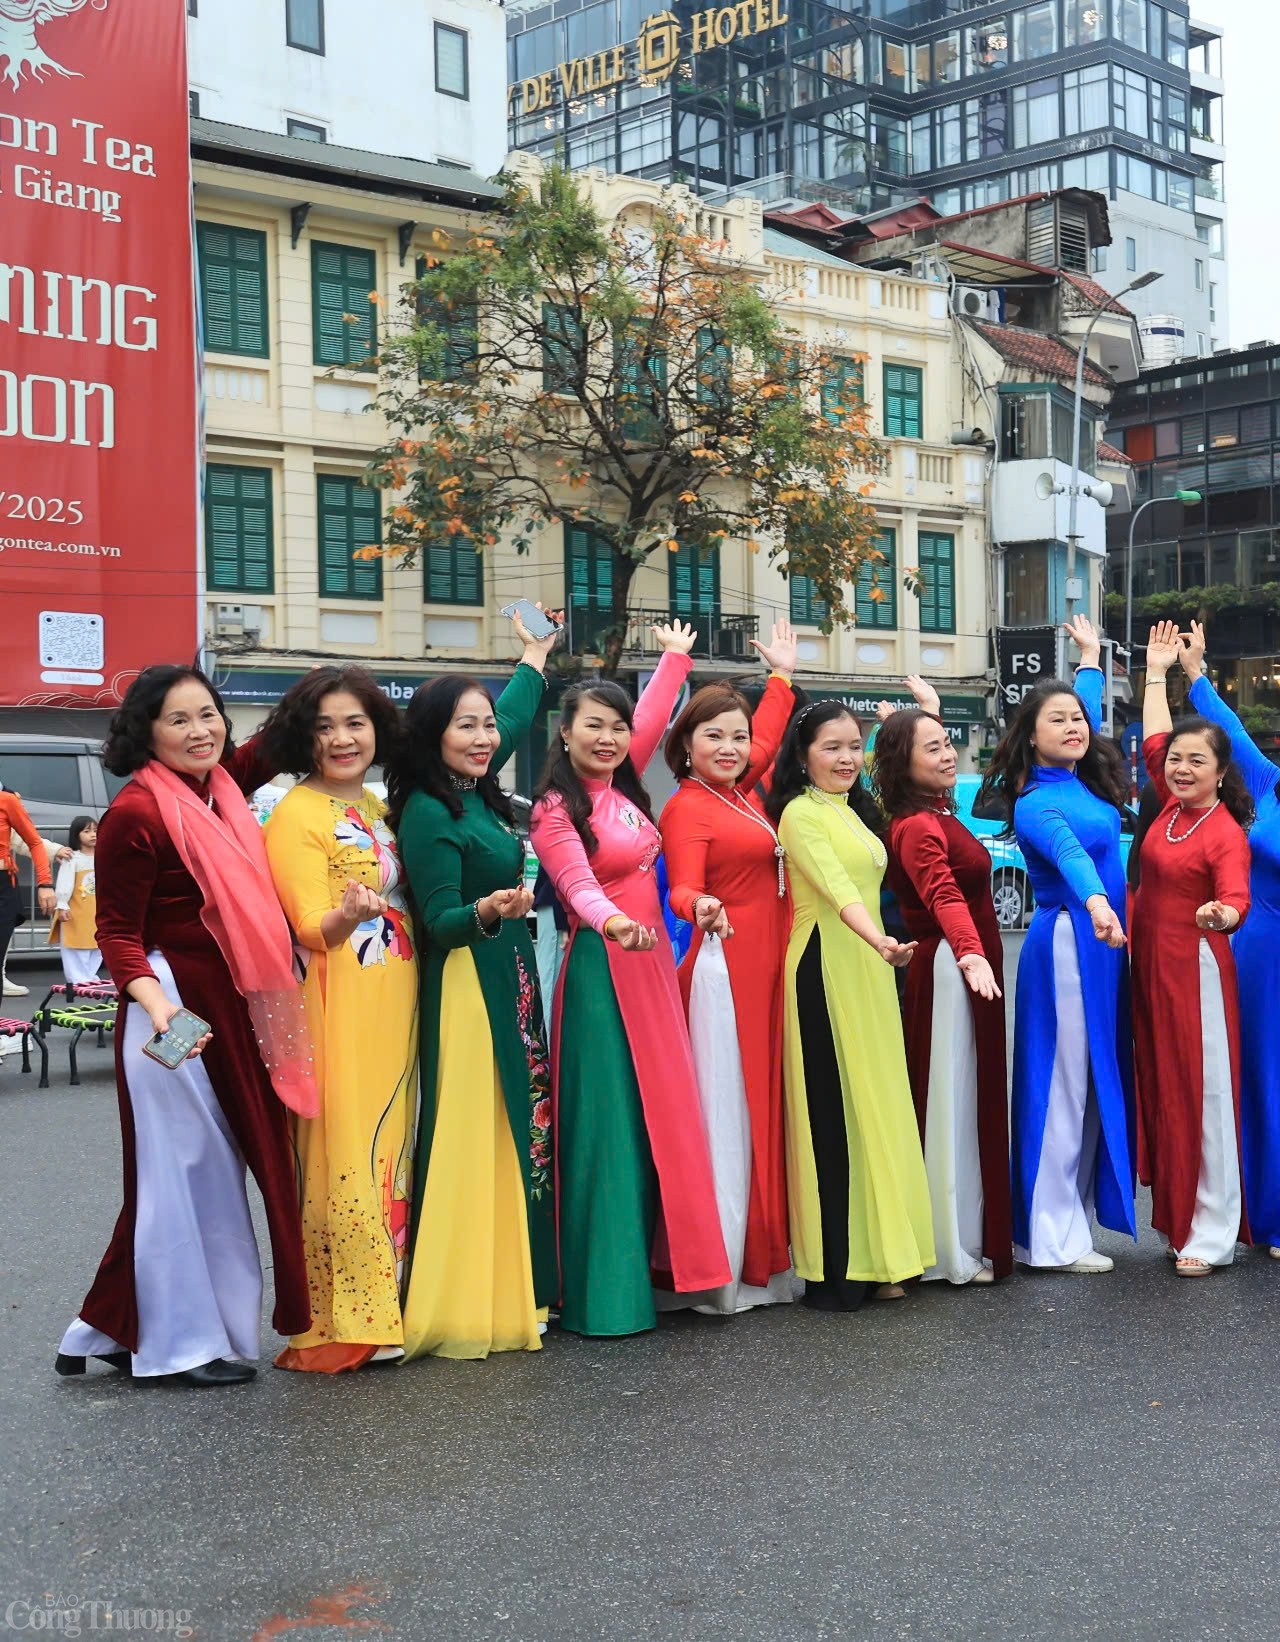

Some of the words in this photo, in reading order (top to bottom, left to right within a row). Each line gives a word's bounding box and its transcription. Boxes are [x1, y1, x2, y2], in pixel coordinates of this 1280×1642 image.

[523, 72, 552, 114] DE
[558, 46, 626, 99] VILLE
[691, 0, 789, 53] HOTEL
[72, 118, 156, 178] Tea
[15, 164, 122, 222] Giang
[1012, 653, 1041, 675] FS
